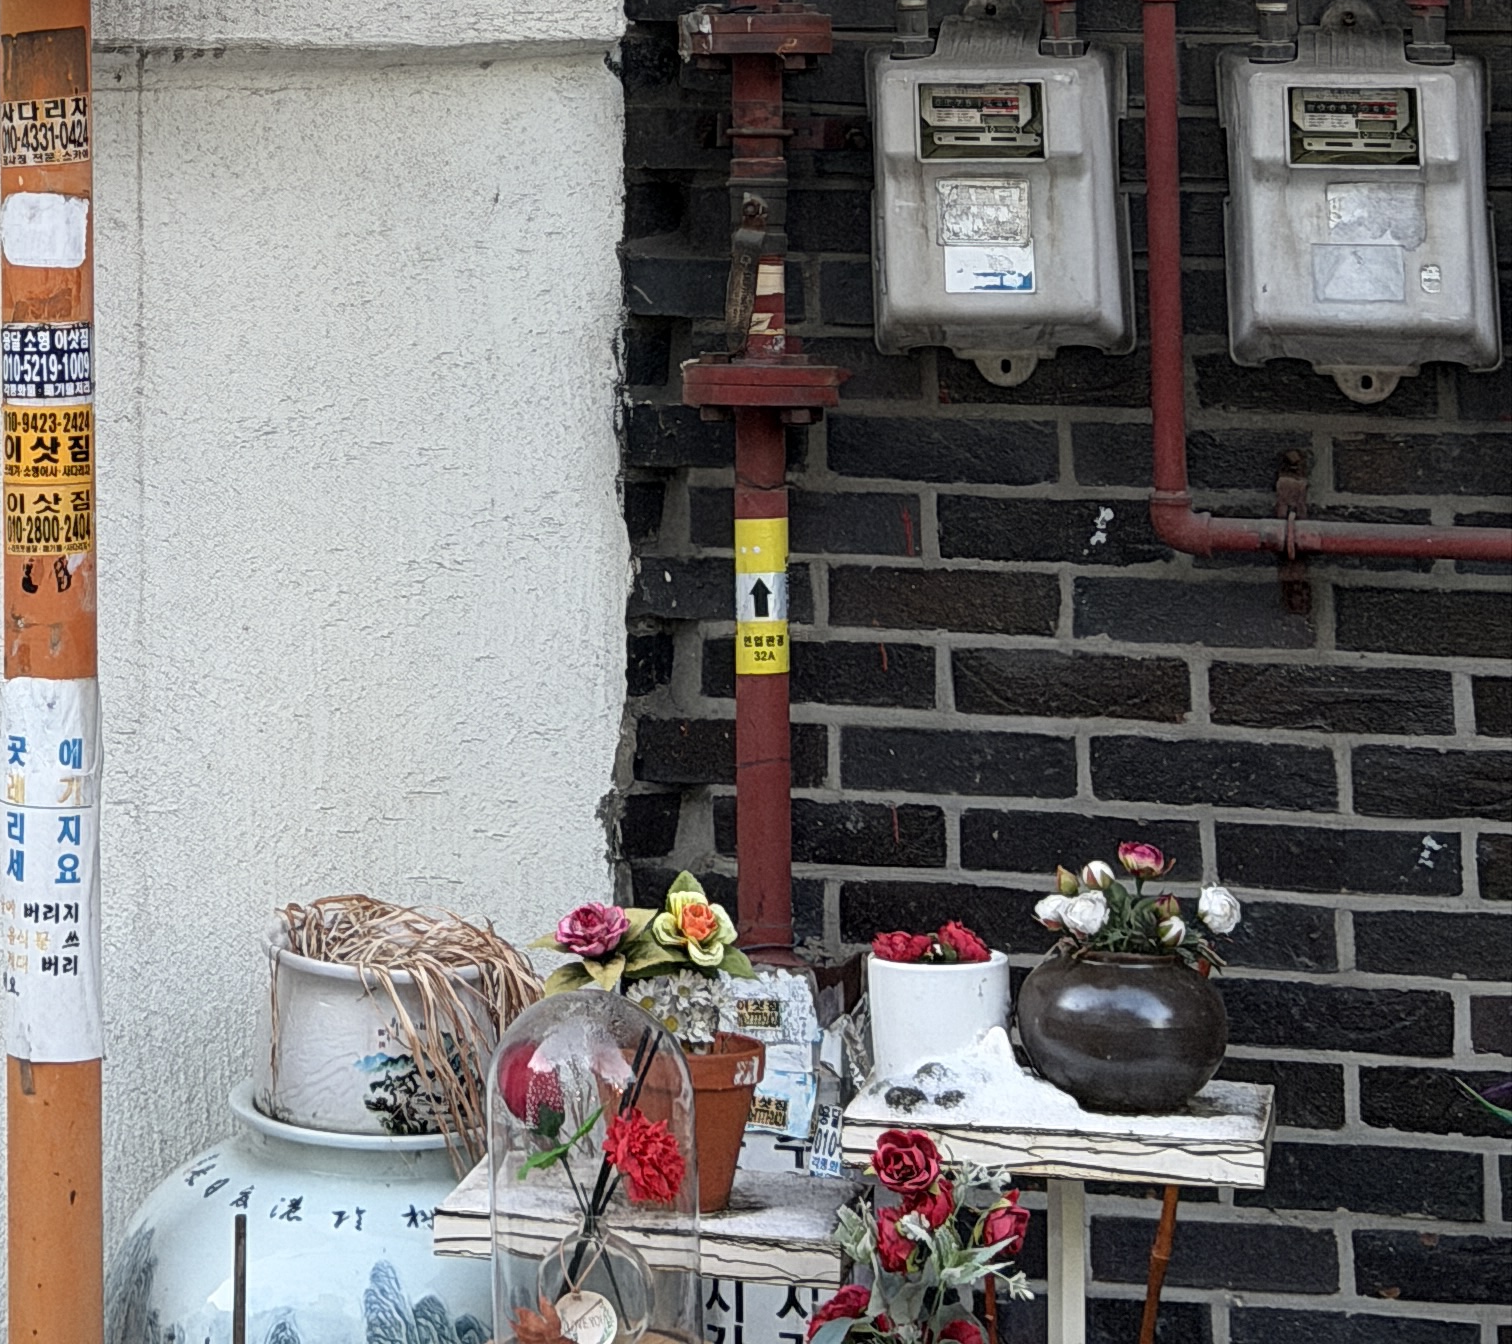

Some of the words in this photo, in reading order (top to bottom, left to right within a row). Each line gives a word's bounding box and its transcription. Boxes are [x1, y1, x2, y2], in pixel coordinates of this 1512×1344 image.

[3, 330, 21, 351] 용달
[24, 330, 51, 352] 소형
[54, 328, 89, 351] 이삿짐
[4, 434, 90, 464] 이삿짐
[7, 490, 90, 514] 이삿짐
[754, 650, 776, 662] 32A
[23, 902, 79, 924] 버리지
[62, 930, 80, 949] 쓰
[41, 955, 79, 977] 버리
